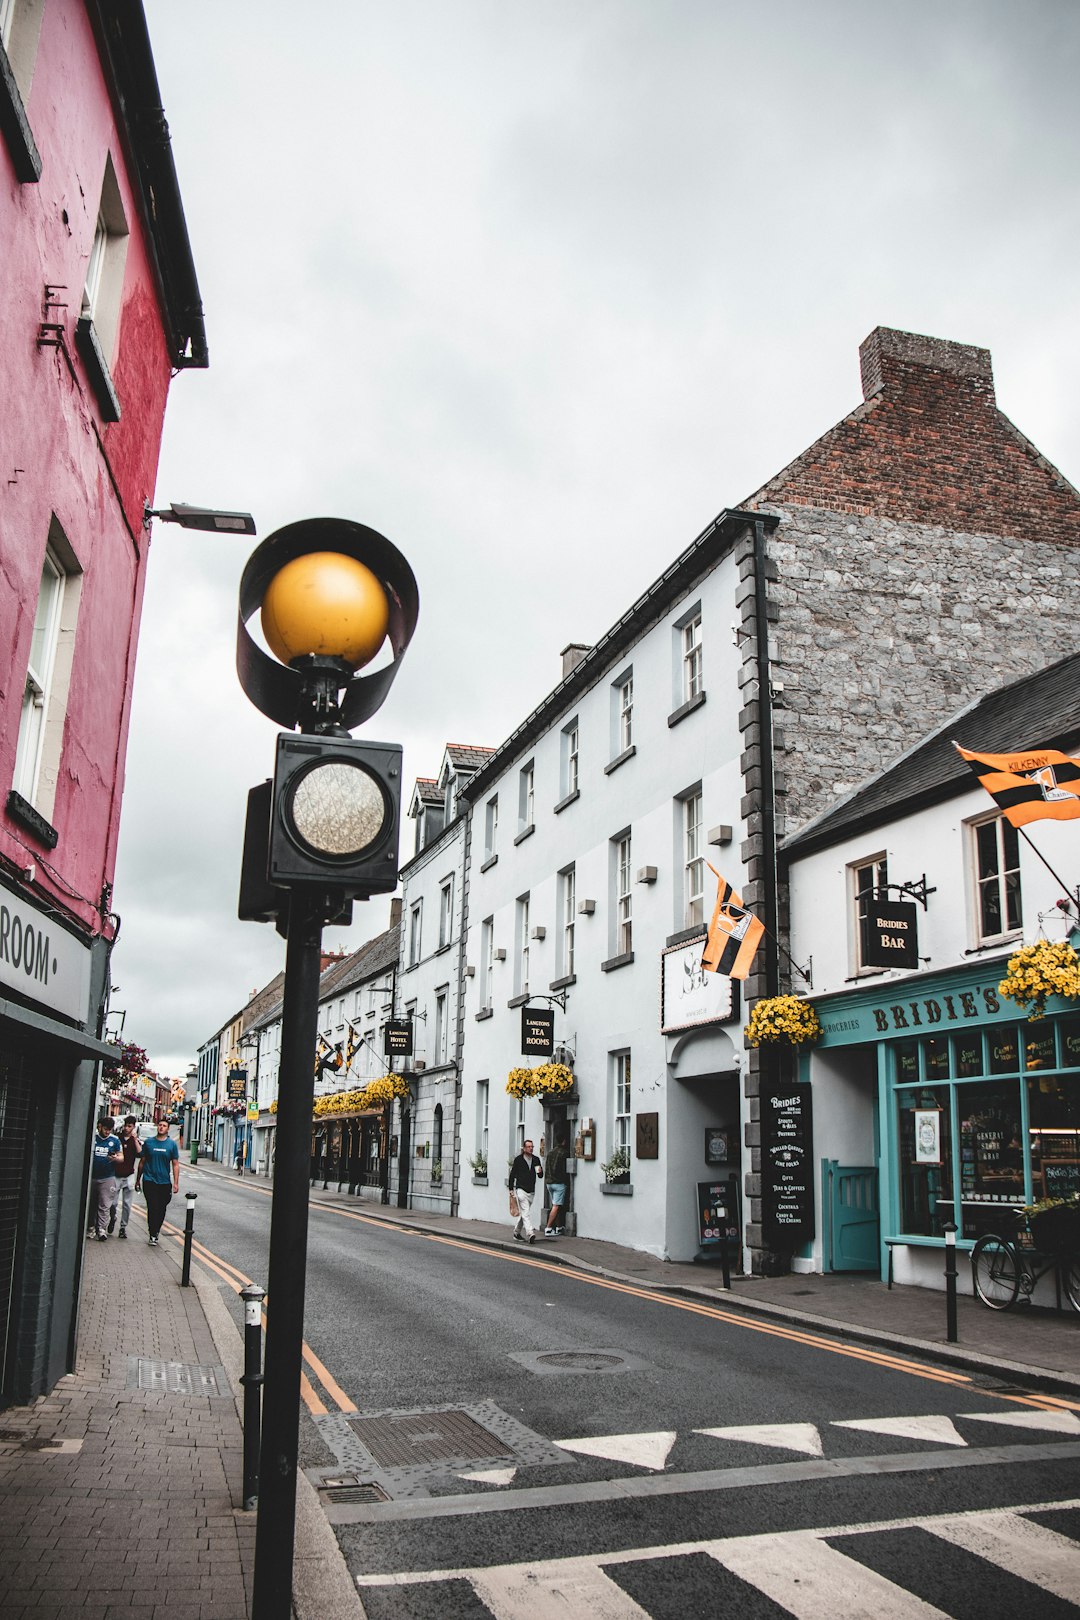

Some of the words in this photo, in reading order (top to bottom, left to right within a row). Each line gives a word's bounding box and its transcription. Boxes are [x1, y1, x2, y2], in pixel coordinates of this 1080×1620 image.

[1008, 756, 1049, 772] KILKENNY
[876, 918, 908, 929] BRIDIES
[0, 905, 49, 985] ROOM
[881, 935, 906, 949] BAR
[873, 986, 1000, 1032] BRIDIE'S
[526, 1019, 551, 1027] LANGTONS
[823, 1019, 860, 1034] GROCERIES
[531, 1028, 545, 1036] TEA
[526, 1037, 550, 1046] ROOMS
[771, 1096, 800, 1108] BRIDIES
[977, 1132, 1003, 1140] GENERAL
[981, 1142, 1000, 1150] STORE
